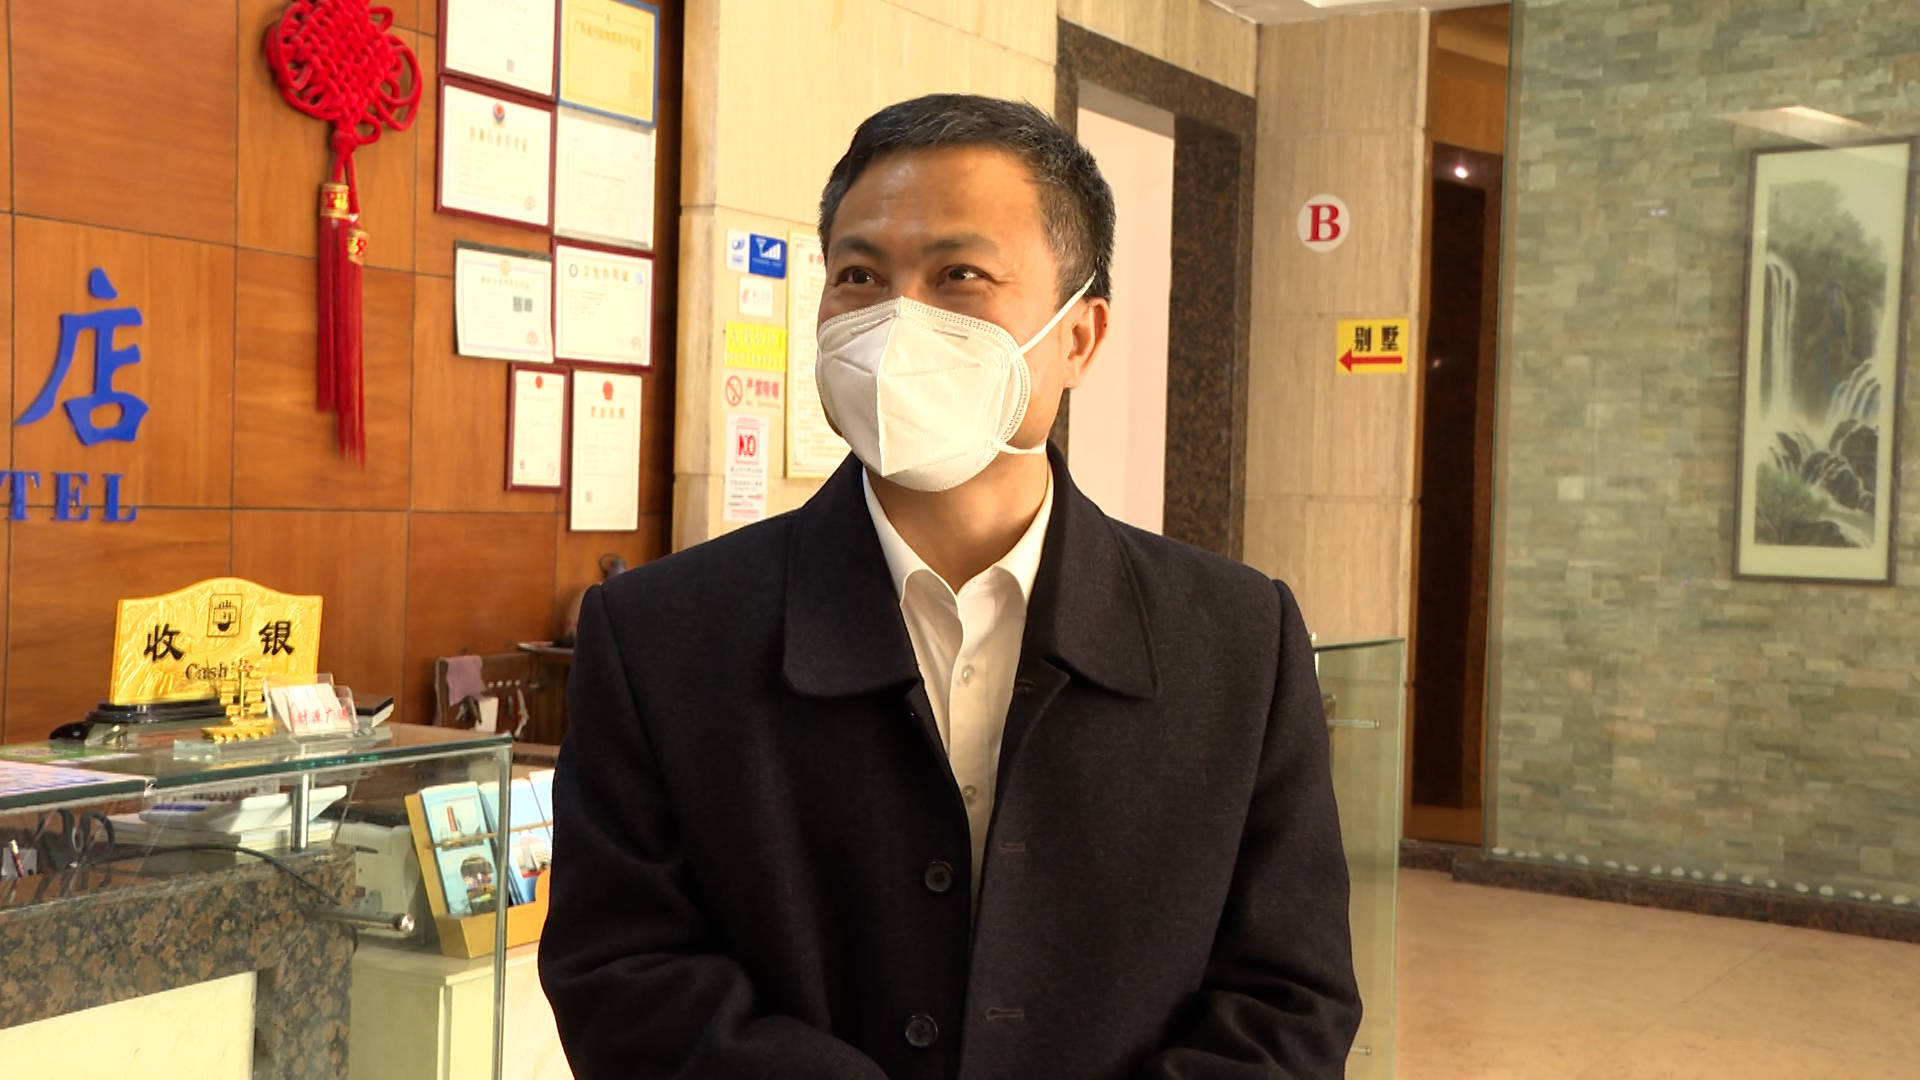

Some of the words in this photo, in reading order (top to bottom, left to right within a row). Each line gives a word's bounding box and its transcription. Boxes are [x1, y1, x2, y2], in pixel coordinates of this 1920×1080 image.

[1305, 203, 1341, 242] B
[12, 267, 150, 446] 店
[1353, 325, 1399, 352] 别墅
[0, 471, 138, 523] TEL
